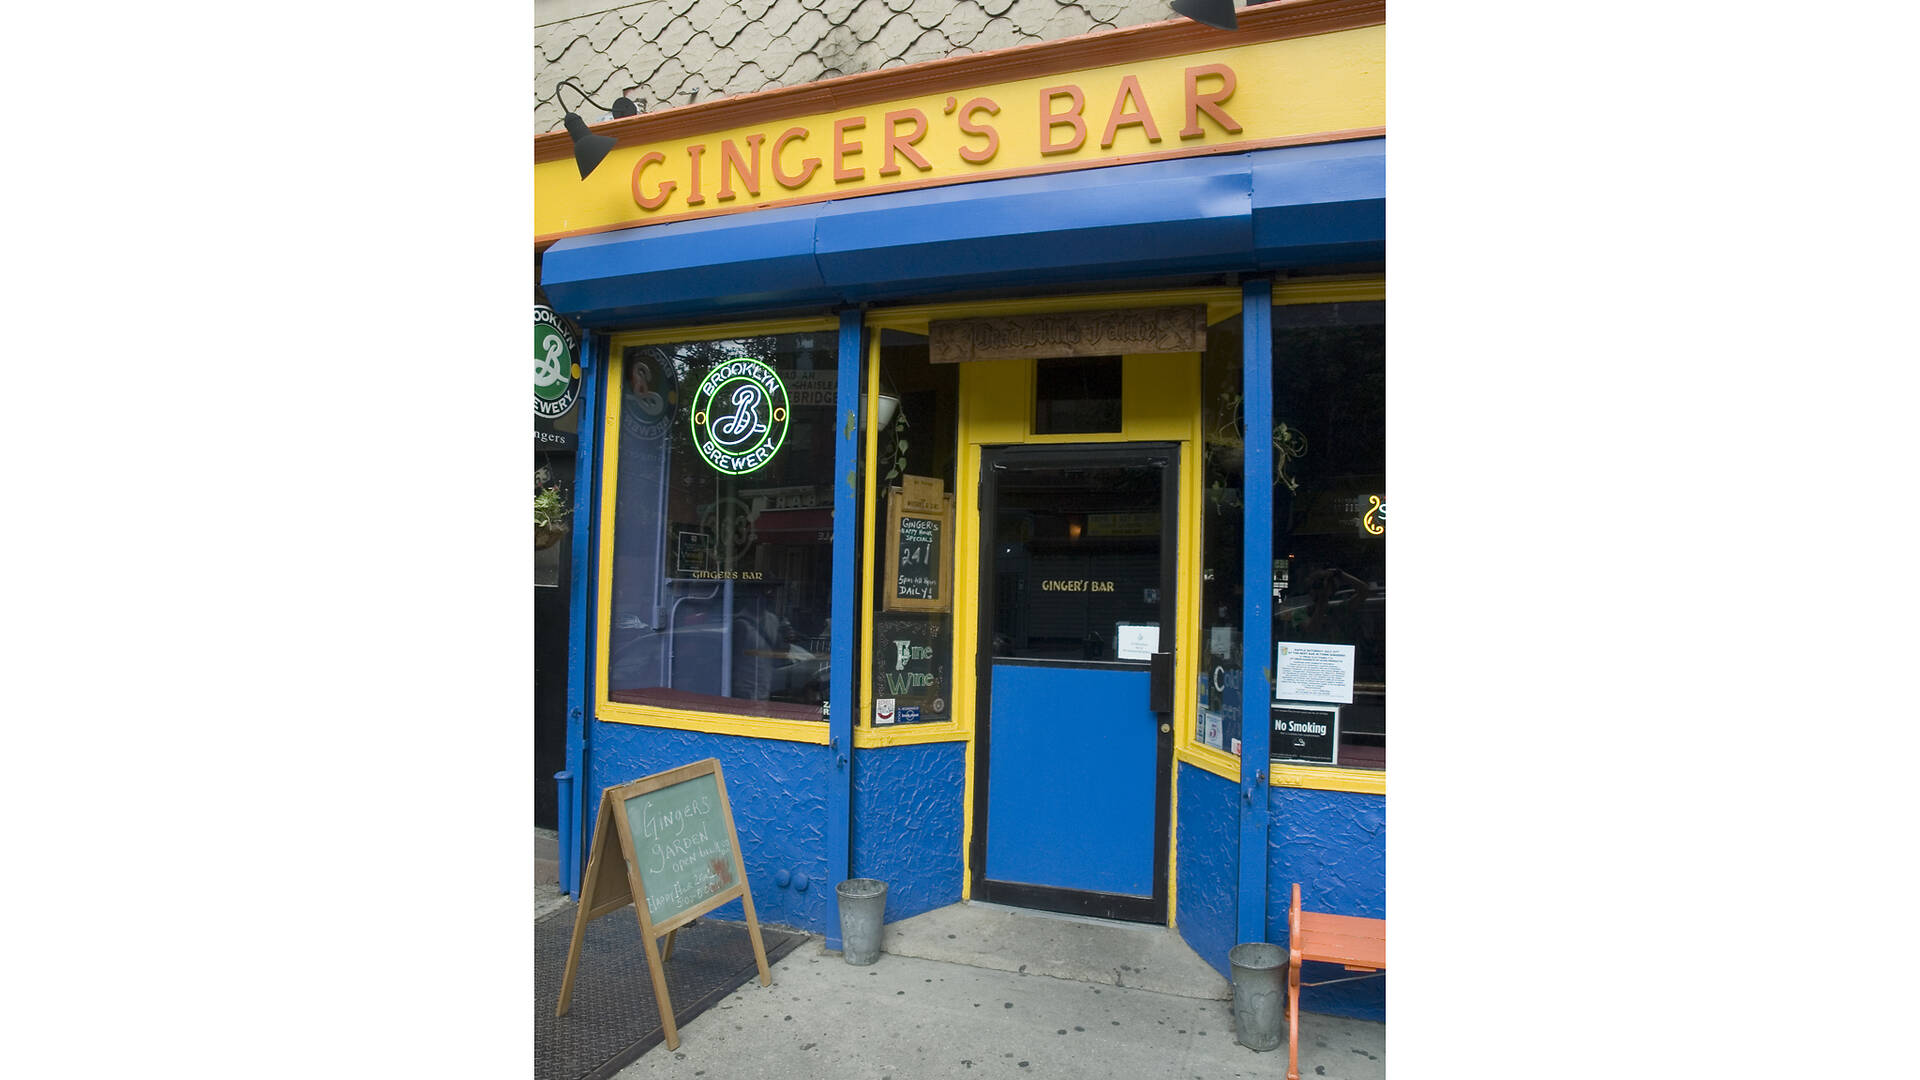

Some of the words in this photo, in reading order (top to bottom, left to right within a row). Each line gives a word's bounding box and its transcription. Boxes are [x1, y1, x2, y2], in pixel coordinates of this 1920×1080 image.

[632, 96, 1000, 210] GINGER'S
[1040, 63, 1243, 157] BAR
[702, 362, 780, 397] BROOKLYN
[702, 437, 775, 471] BREWERY
[902, 518, 939, 531] GINGER'S
[905, 535, 933, 543] SPECIALS
[742, 571, 763, 580] BAR
[1042, 579, 1089, 592] GINGER'S
[1092, 581, 1115, 592] BAR
[893, 640, 933, 671] Fine
[886, 672, 934, 696] Wine
[1274, 719, 1287, 731] No
[1288, 720, 1327, 736] Smoking
